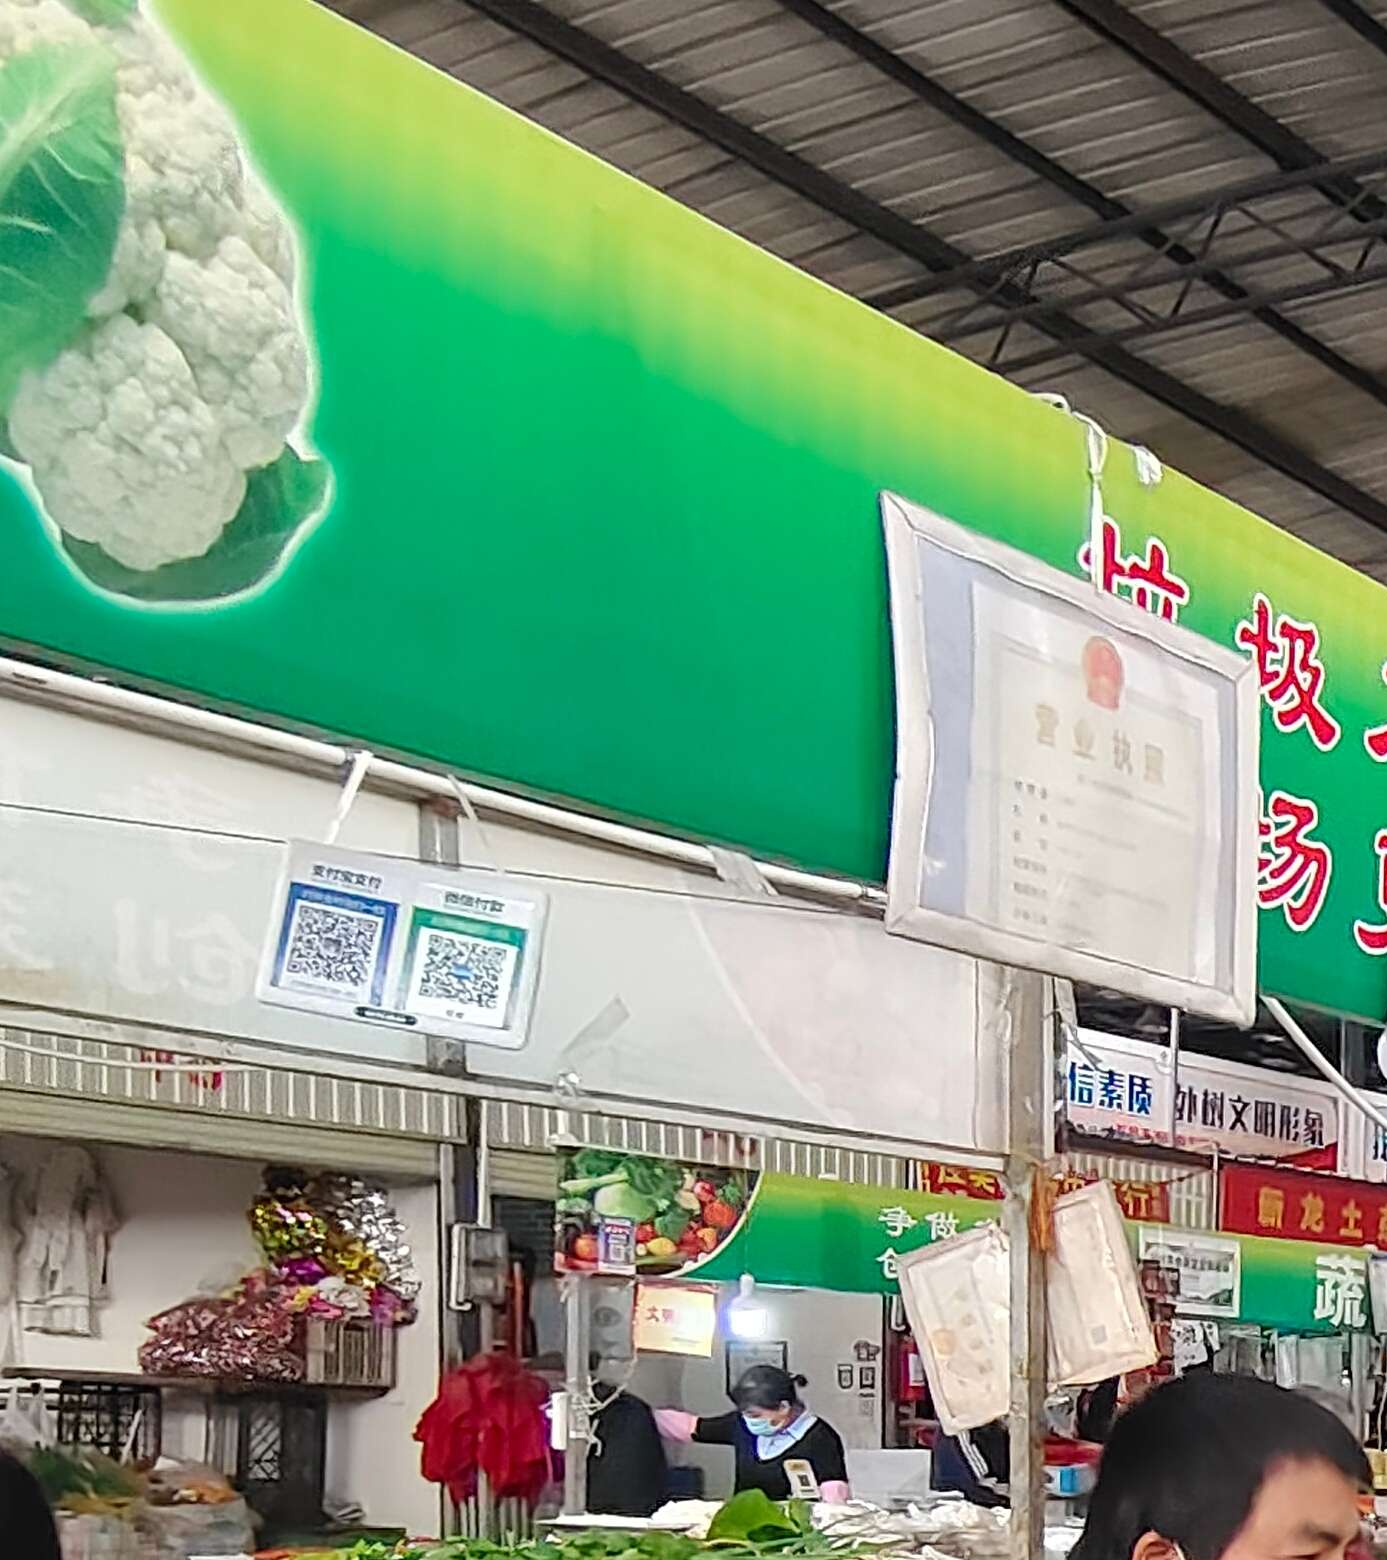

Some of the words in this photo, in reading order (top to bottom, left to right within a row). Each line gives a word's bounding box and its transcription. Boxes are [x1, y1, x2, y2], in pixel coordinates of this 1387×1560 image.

[312, 864, 383, 889] 支付宝支付
[1068, 1061, 1152, 1116] 信素质
